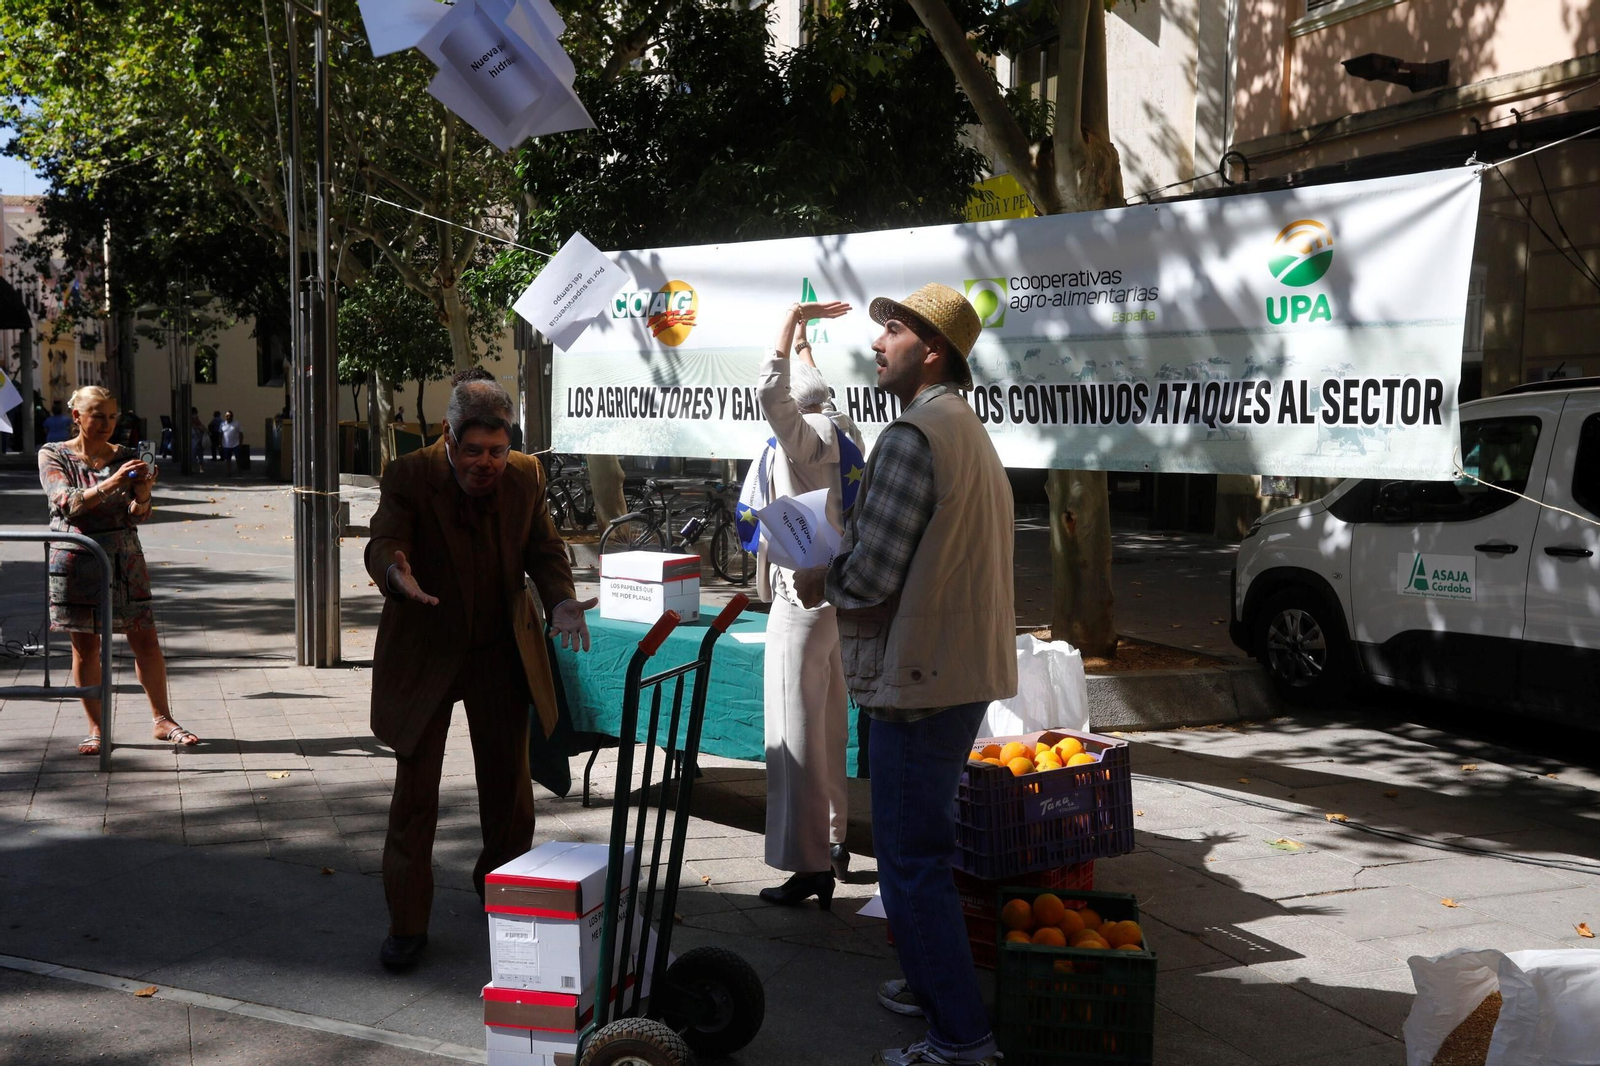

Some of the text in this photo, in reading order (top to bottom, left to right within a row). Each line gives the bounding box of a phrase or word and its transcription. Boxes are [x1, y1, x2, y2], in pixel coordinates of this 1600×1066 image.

[470, 47, 499, 72] Nueva
[975, 201, 1000, 219] VIDA
[1003, 197, 1010, 213] Y
[553, 272, 583, 306] del campo
[1010, 269, 1122, 292] cooperativas
[549, 266, 605, 327] Por la supervivencia
[611, 290, 694, 319] COAG
[1009, 286, 1159, 313] agro-alimentarias
[1112, 309, 1156, 323] España
[1265, 293, 1332, 325] UPA
[567, 386, 594, 418] LOS
[596, 386, 714, 420] AGRICULTORES
[717, 387, 728, 420] Y
[846, 386, 904, 423] HART
[963, 385, 1004, 424] OS
[1008, 383, 1149, 425] CONTINUOS
[1151, 379, 1271, 429] ATAQUES
[1277, 379, 1315, 425] AL
[1322, 378, 1444, 426] SECTOR
[783, 511, 807, 556] urocracia,
[1432, 570, 1469, 582] ASAJA
[1432, 582, 1471, 593] Córdoba
[621, 584, 642, 592] PAPELES
[632, 594, 652, 602] PLANAS
[588, 914, 598, 928] LOS
[591, 929, 599, 942] ME
